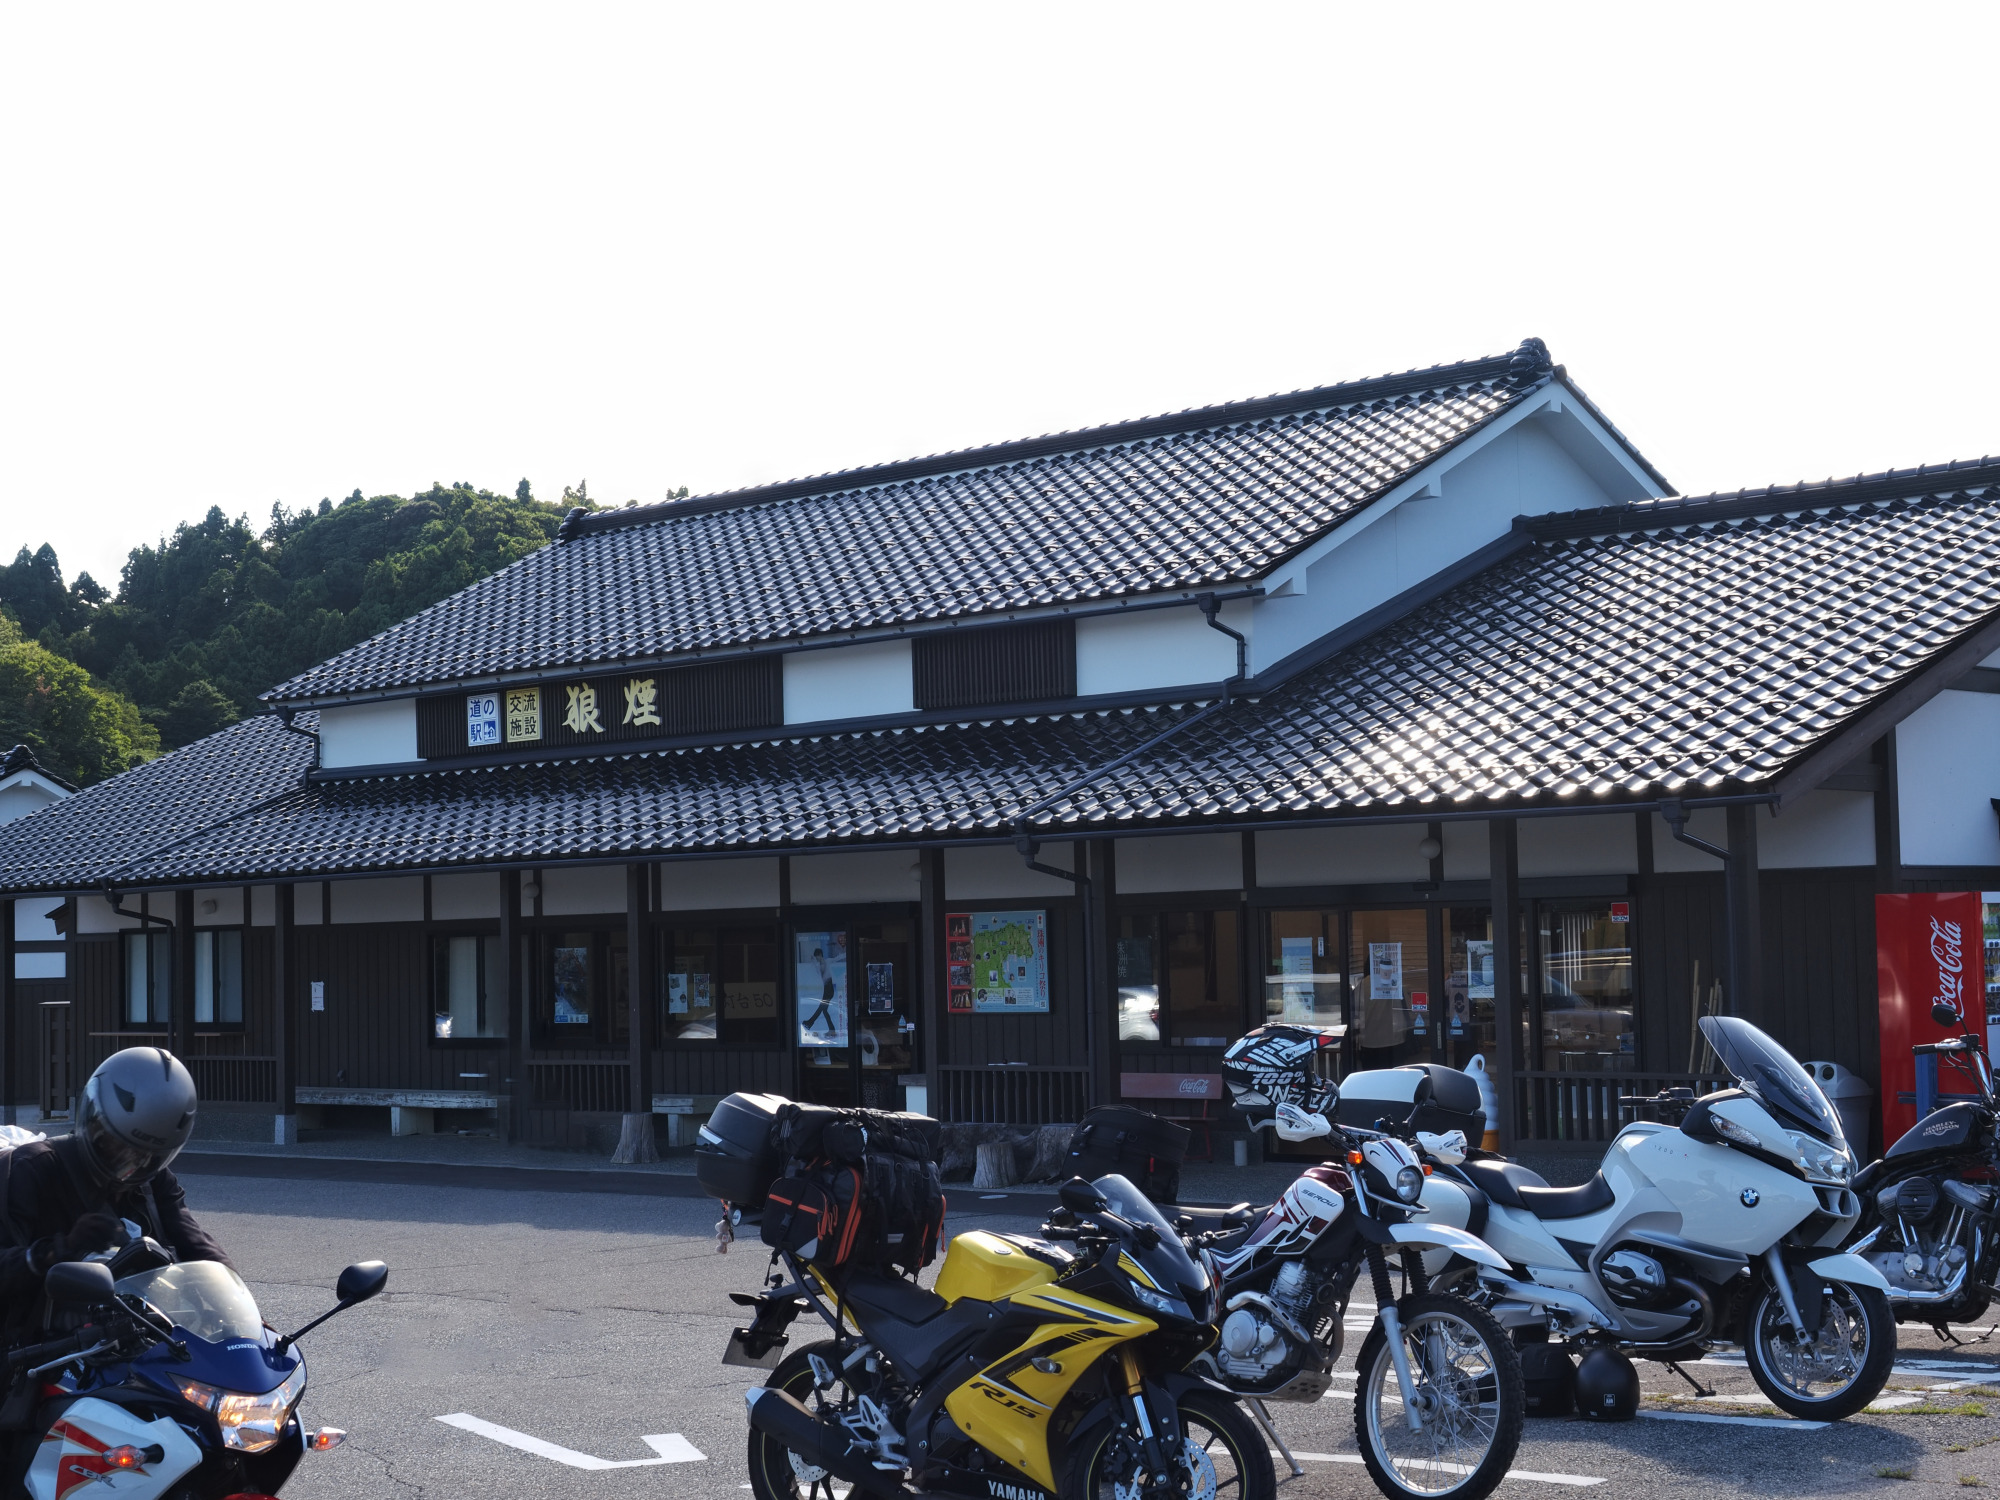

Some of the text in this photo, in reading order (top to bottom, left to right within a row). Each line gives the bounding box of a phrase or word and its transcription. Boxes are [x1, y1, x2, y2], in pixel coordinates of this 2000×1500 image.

[469, 699, 495, 718] 道の
[509, 693, 537, 714] 交流
[562, 678, 662, 734] 狼煙
[470, 723, 483, 742] 駅
[509, 717, 537, 737] 施設
[1179, 1078, 1209, 1094] Coca-Cola
[1251, 1071, 1306, 1085] 100%
[1922, 1124, 1960, 1137] DAVIDSON
[1301, 1189, 1338, 1207] SEROW
[226, 1343, 259, 1352] HONDA
[969, 1382, 1044, 1419] R15
[68, 1464, 116, 1489] CBR
[987, 1479, 1046, 1500] YAMAHA
